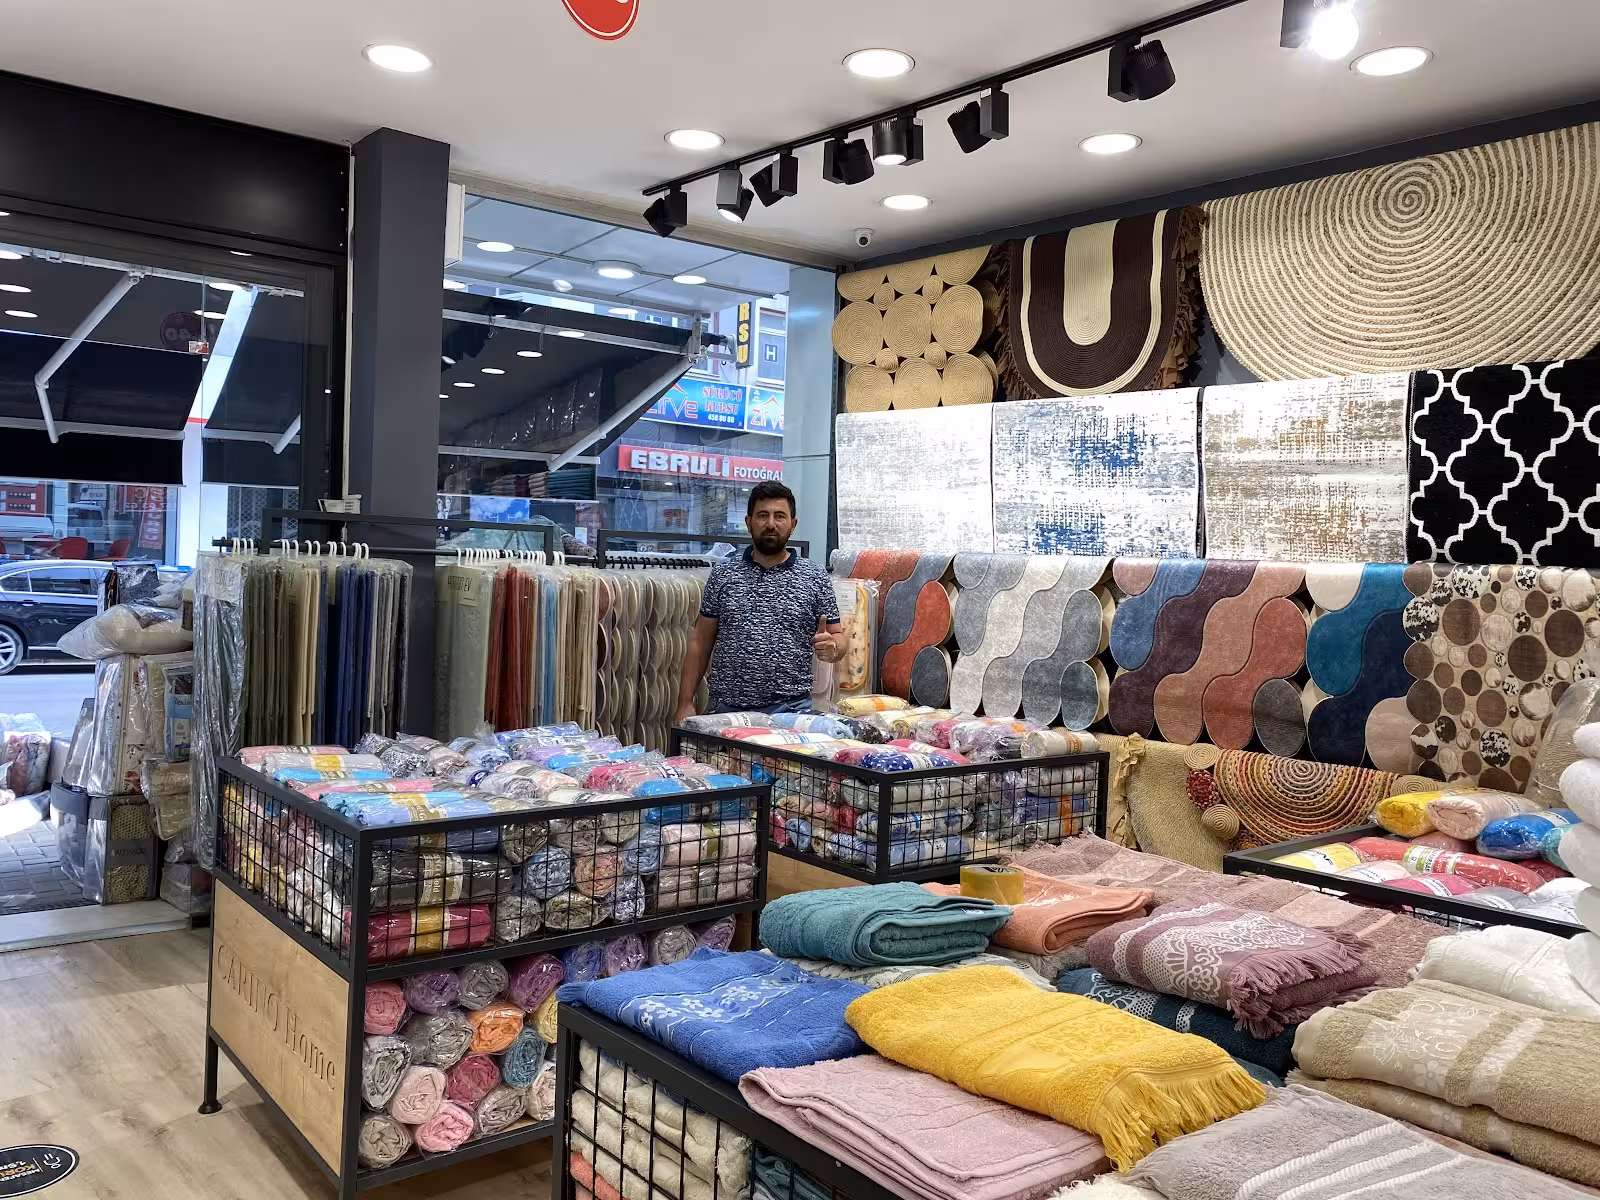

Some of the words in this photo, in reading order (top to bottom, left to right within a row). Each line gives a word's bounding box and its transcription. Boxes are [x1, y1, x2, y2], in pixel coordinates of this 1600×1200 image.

[705, 400, 739, 415] KURSU
[630, 449, 730, 478] EBRULİ
[733, 466, 783, 481] FOTOĞRA
[217, 944, 279, 1032] CARINO
[285, 1006, 336, 1092] Home
